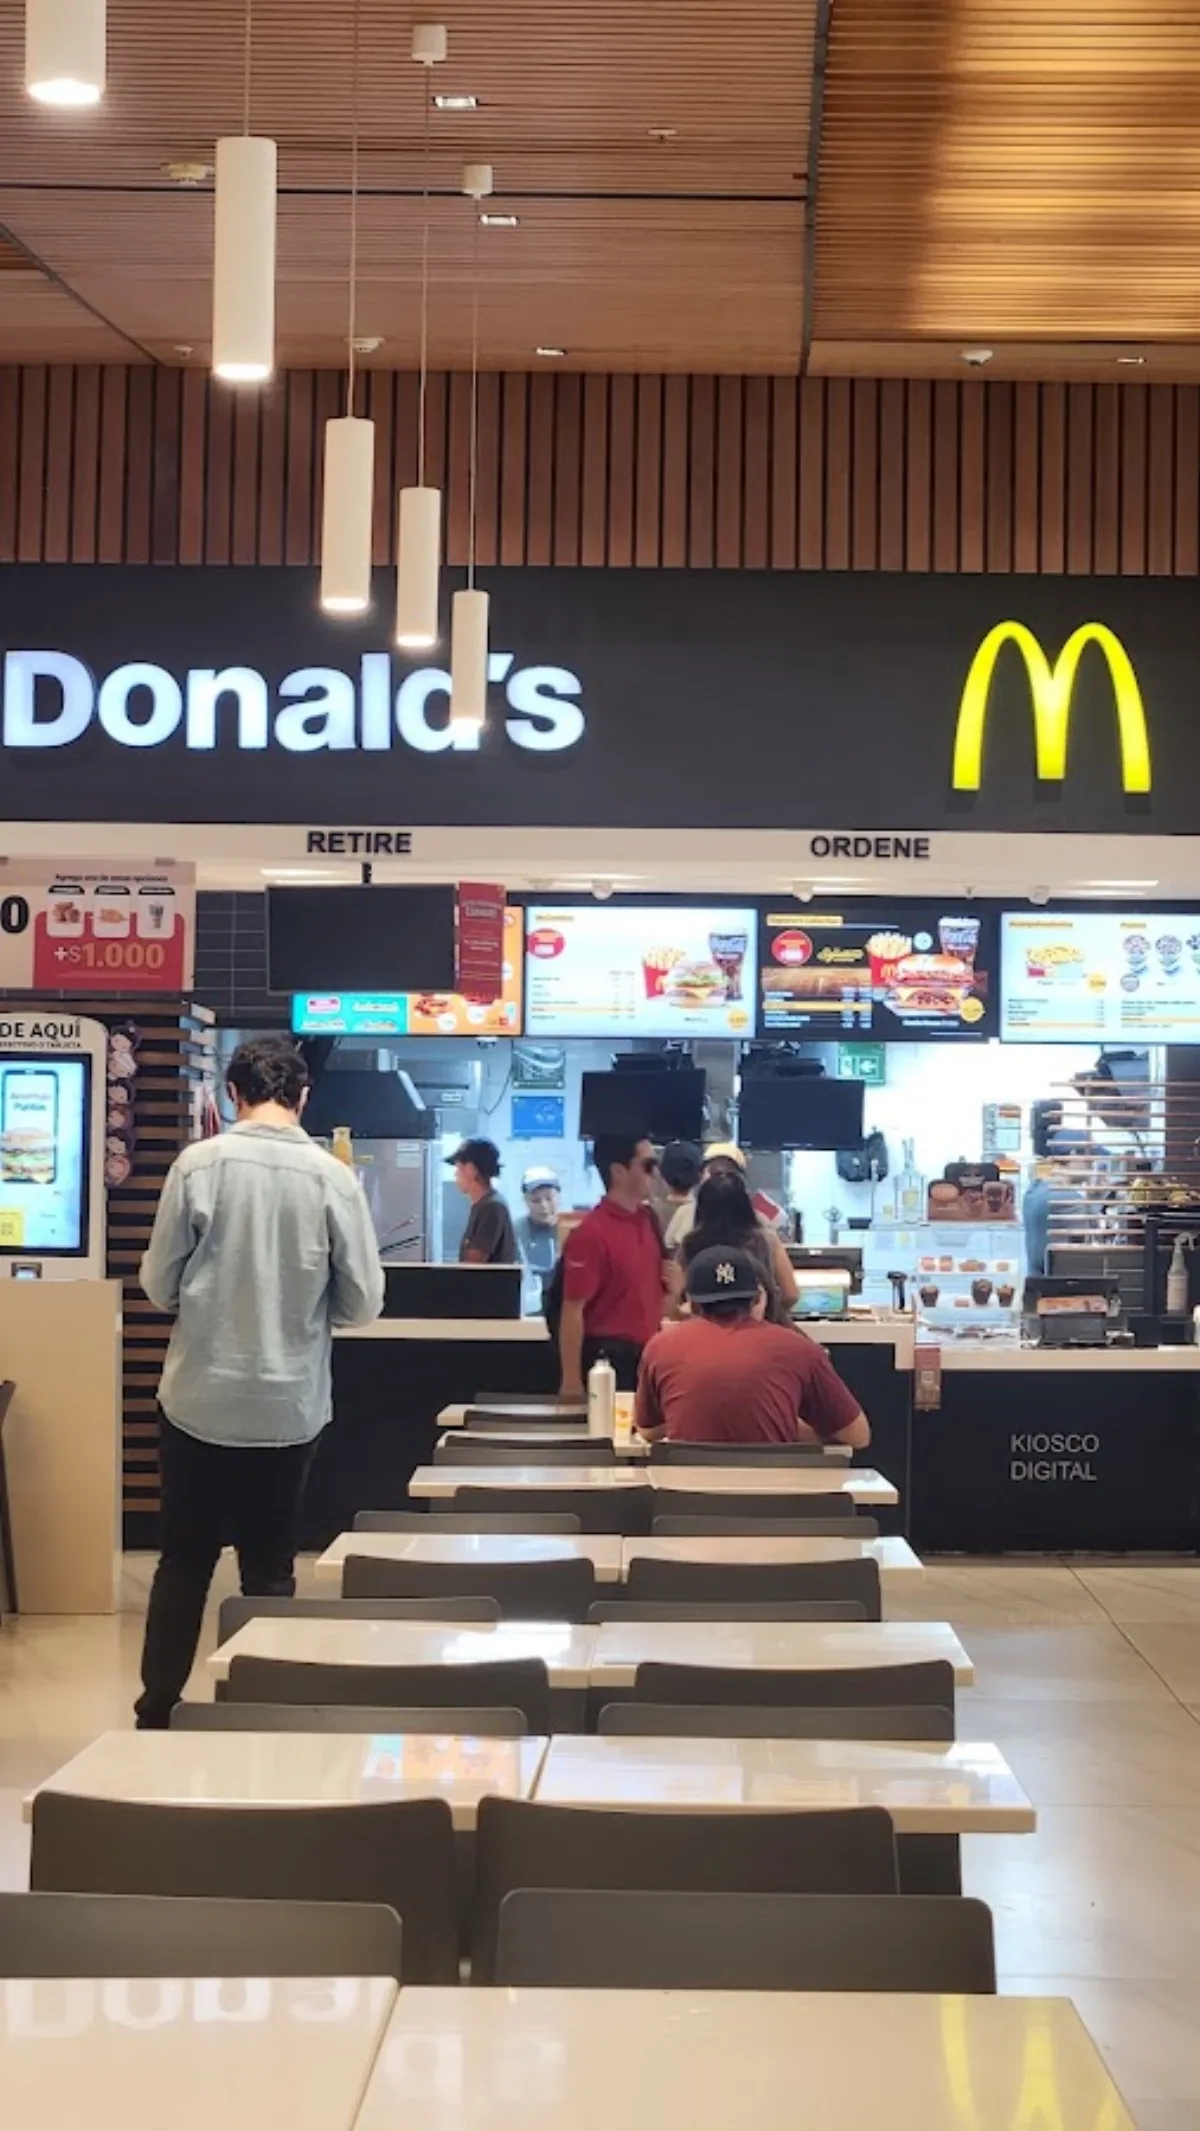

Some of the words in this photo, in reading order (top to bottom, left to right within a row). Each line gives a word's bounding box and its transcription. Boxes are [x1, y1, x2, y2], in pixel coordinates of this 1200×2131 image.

[3, 650, 586, 752] Donald's
[307, 831, 412, 854] RETIRE
[810, 836, 930, 860] ORDENE
[30, 1018, 81, 1040] AQUÍ
[1011, 1433, 1099, 1453] KIOSCO
[1011, 1461, 1097, 1480] DIGITAL
